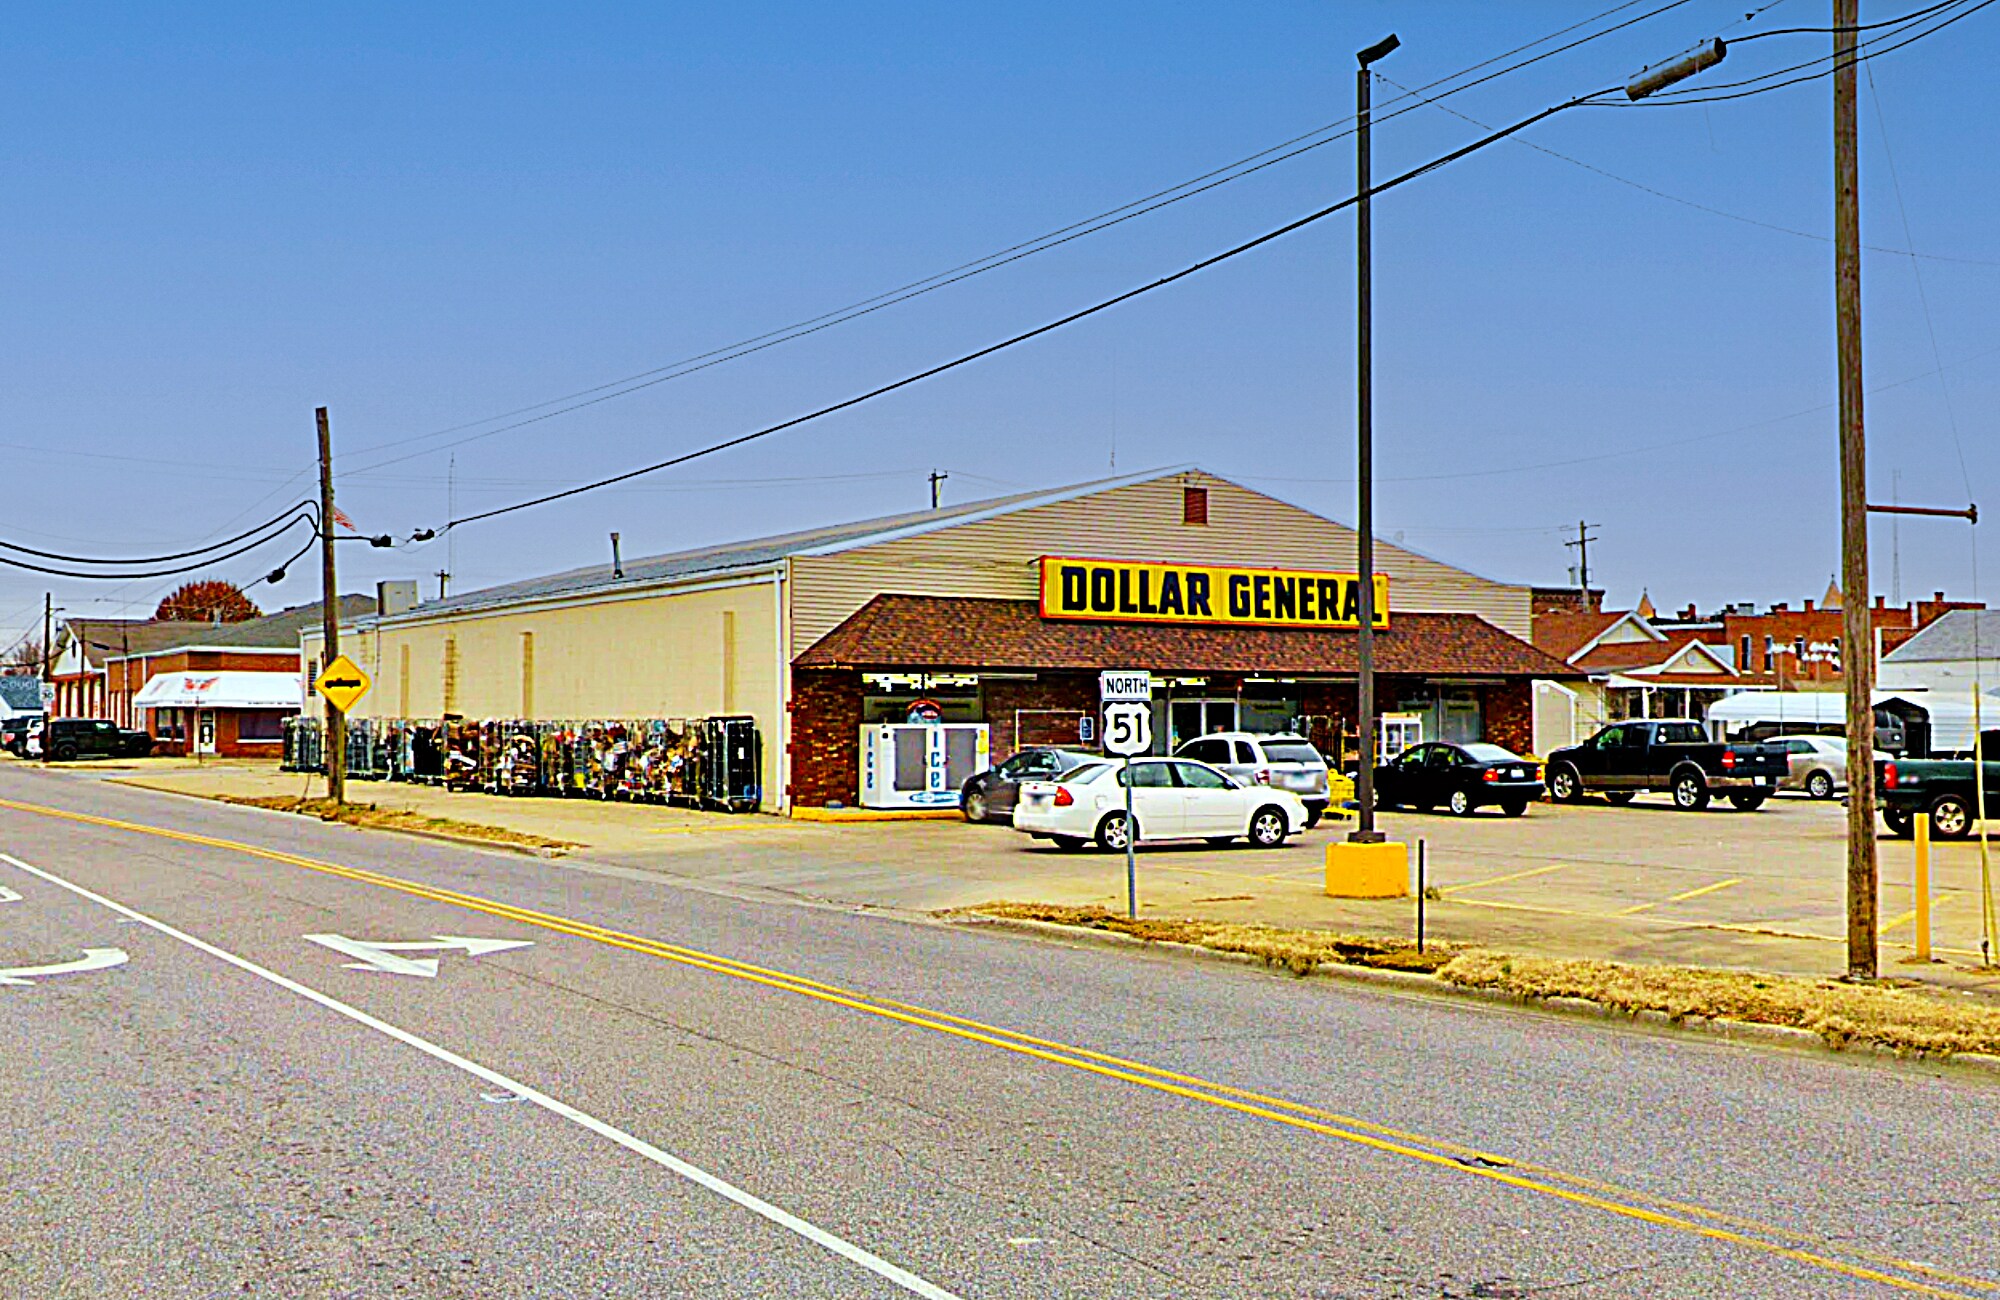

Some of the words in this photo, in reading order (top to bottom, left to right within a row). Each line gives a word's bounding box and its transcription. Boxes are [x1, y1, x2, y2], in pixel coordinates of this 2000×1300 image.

[1061, 566, 1212, 616] DOLLAR
[1106, 678, 1148, 693] NORTH
[1114, 712, 1142, 743] 51
